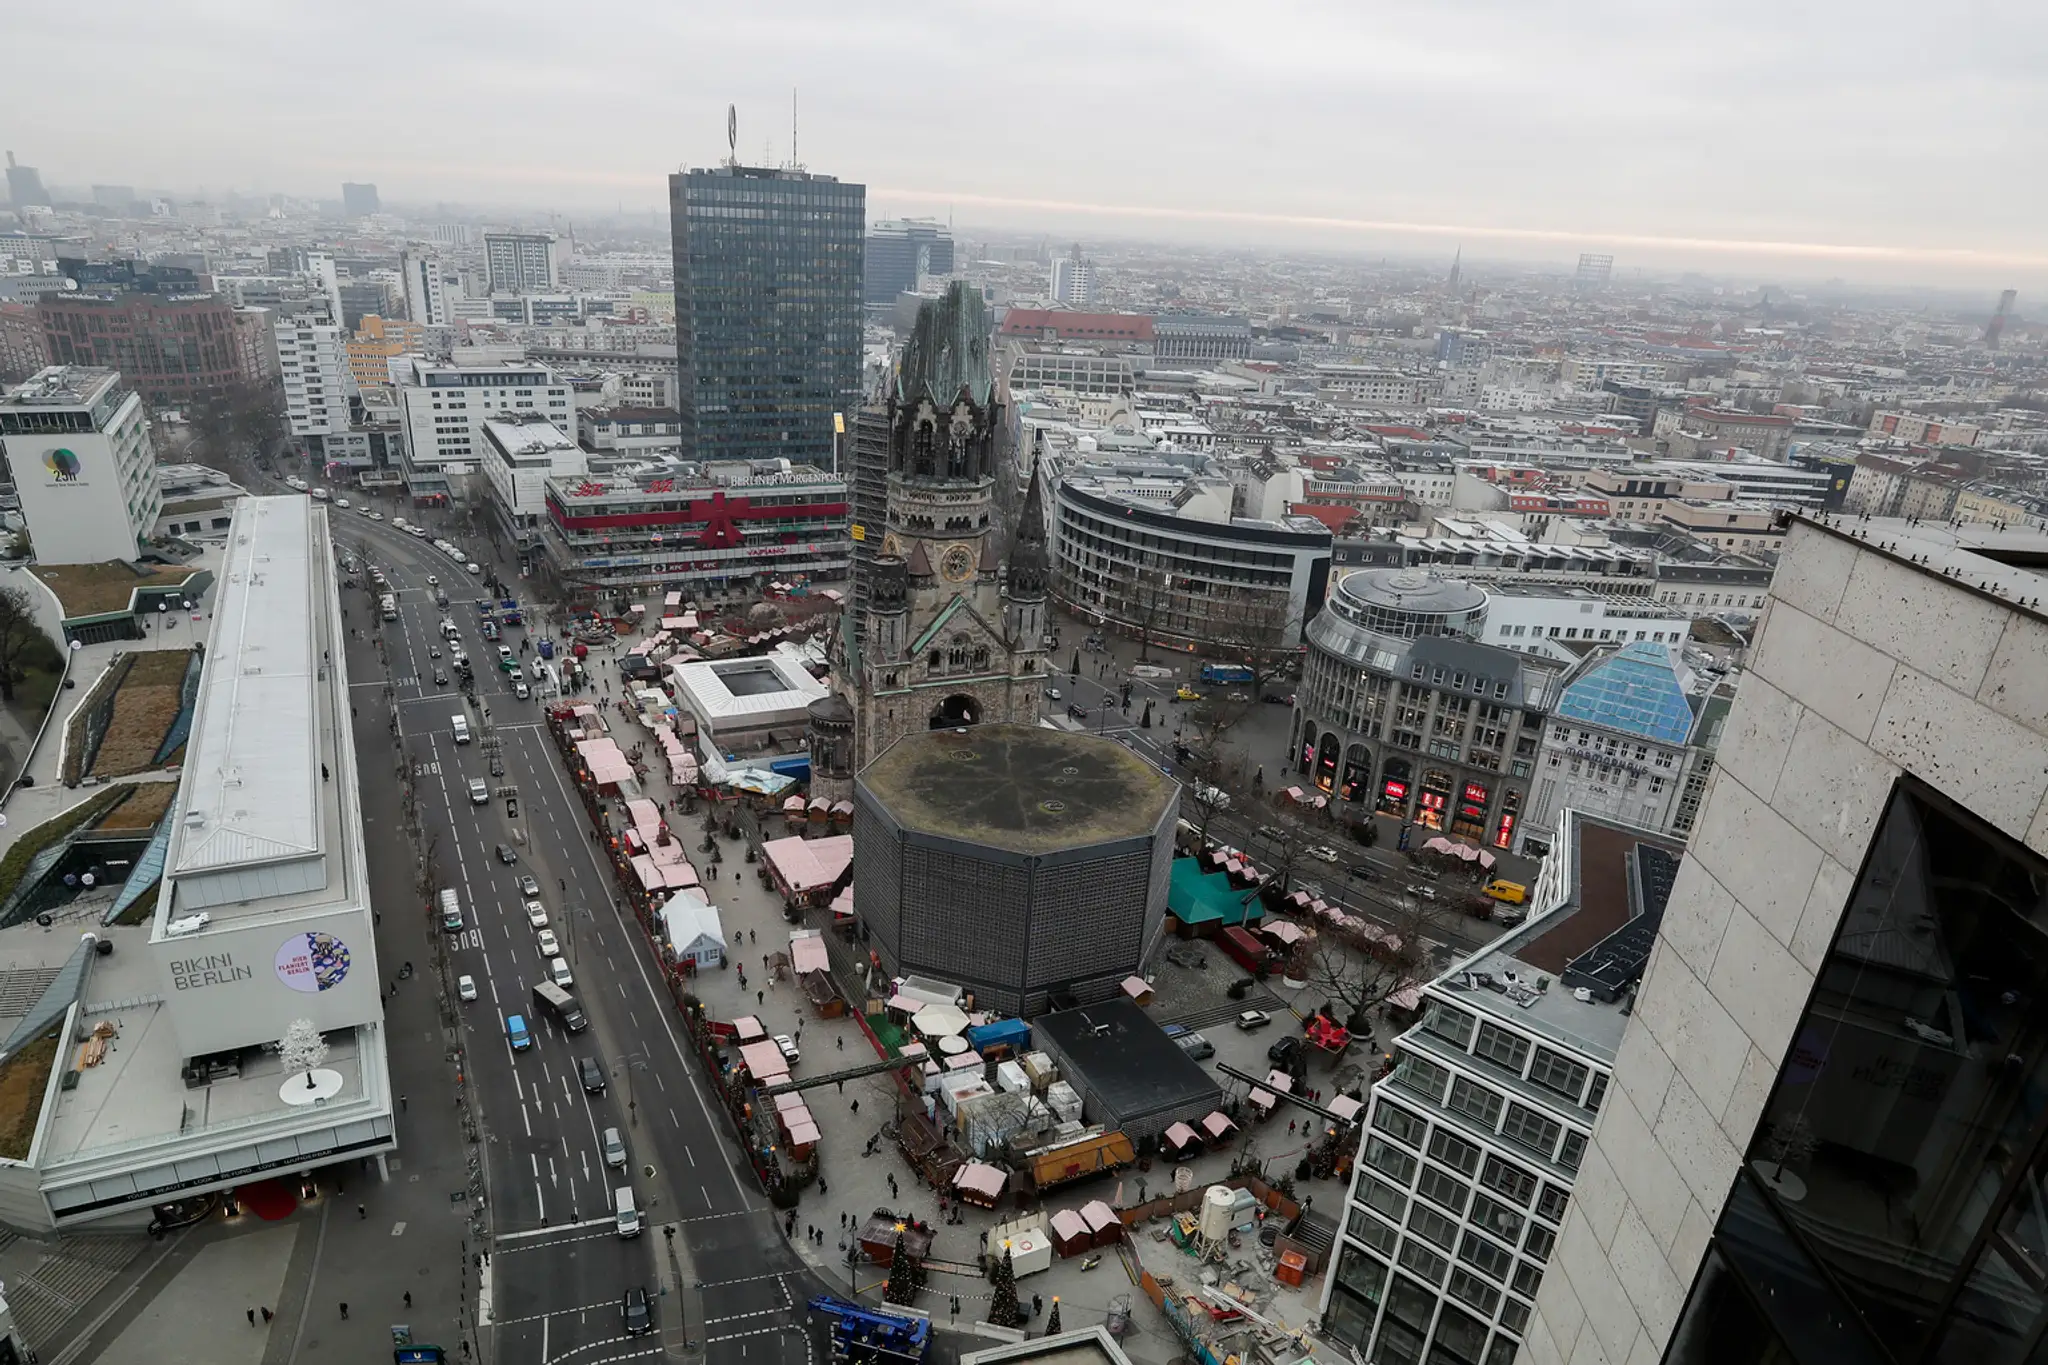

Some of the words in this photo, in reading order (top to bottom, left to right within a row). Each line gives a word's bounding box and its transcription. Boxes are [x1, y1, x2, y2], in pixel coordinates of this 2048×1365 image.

[731, 474, 778, 487] BERLINER
[779, 472, 844, 485] MORGENPOST
[747, 547, 787, 556] VAPIANO
[415, 762, 438, 776] BUS
[451, 929, 479, 952] BUS
[170, 952, 232, 976] BIKINI
[174, 965, 252, 991] BERLIN
[413, 1351, 422, 1359] U
